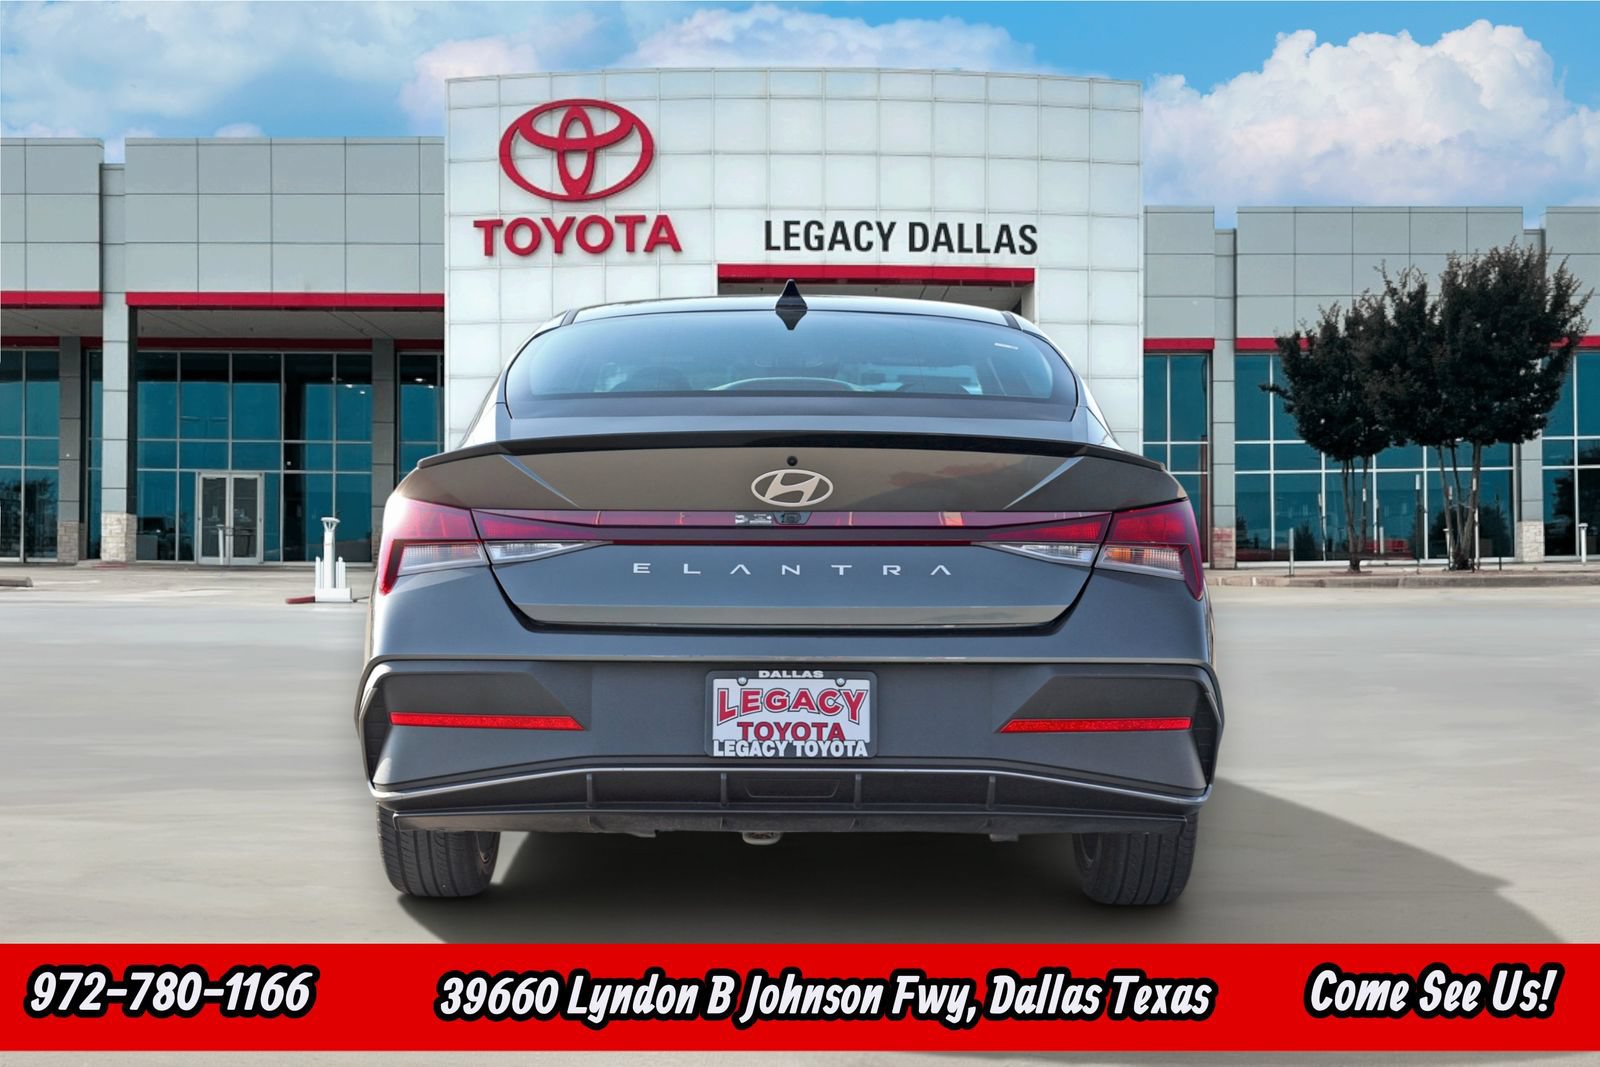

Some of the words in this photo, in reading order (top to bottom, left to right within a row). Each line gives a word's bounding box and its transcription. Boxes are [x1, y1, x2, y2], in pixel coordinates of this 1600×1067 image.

[474, 214, 682, 256] TOYOTA
[764, 220, 897, 252] LEGACY
[908, 221, 1038, 255] DALLAS
[633, 562, 951, 576] ELANTRA
[758, 670, 824, 679] DALLAS
[717, 688, 868, 726] LEGACY
[737, 721, 846, 742] TOYOTA
[713, 740, 786, 758] LEGACY
[793, 740, 868, 758] TOYOTA
